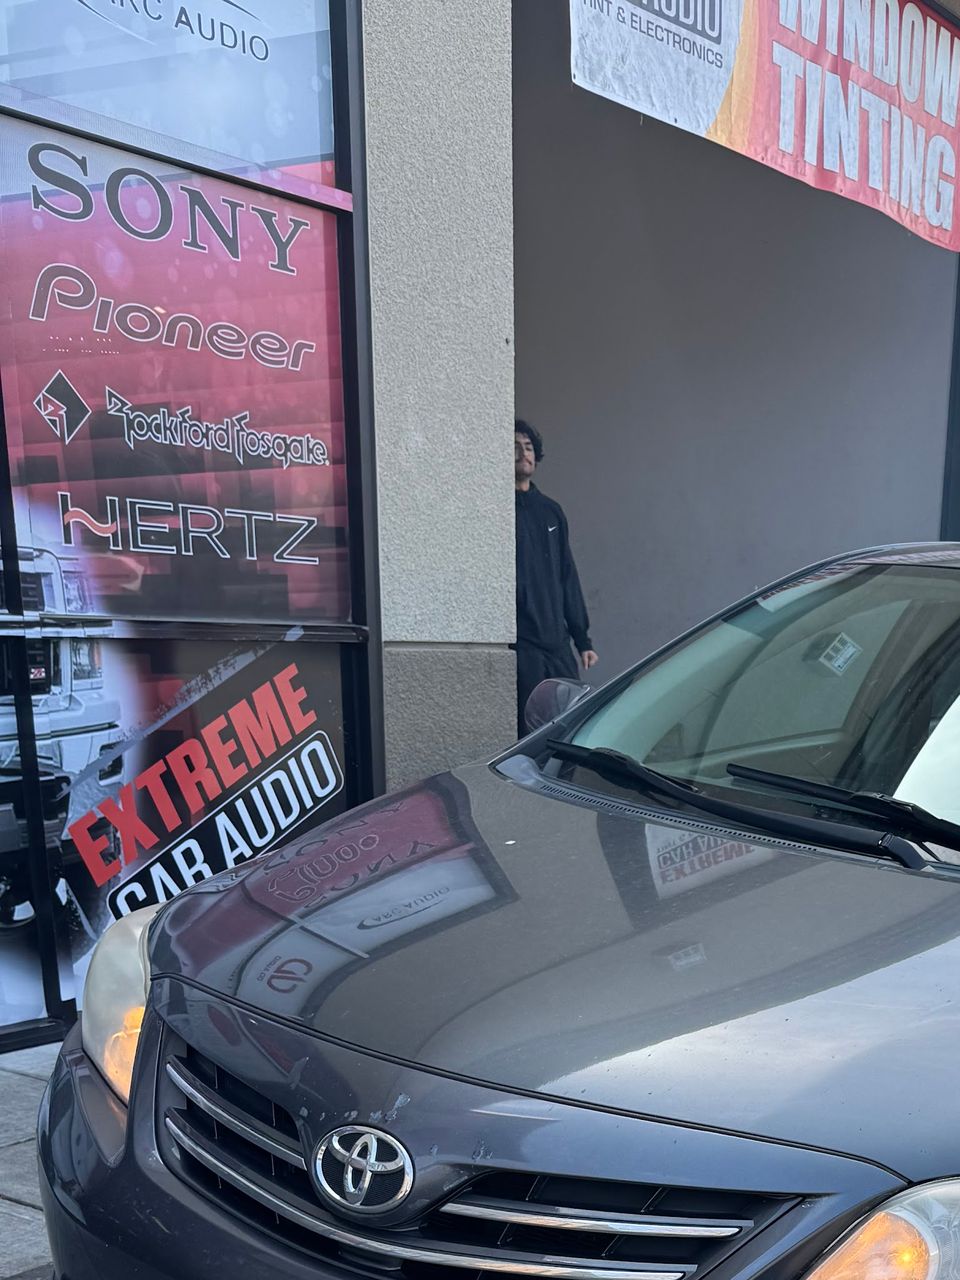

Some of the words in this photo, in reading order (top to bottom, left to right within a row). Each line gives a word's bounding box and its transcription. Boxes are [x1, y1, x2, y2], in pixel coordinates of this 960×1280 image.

[174, 6, 270, 61] AUDIO
[583, 0, 612, 17] INT
[616, 6, 626, 24] &
[630, 12, 724, 69] ELECTRONICS
[771, 40, 957, 232] TINTING
[27, 142, 310, 276] SONY
[29, 263, 317, 371] Pioneer
[57, 491, 319, 565] HERTZ
[68, 663, 318, 888] EXTREME
[116, 838, 214, 918] CAR
[215, 740, 338, 866] AUDIO
